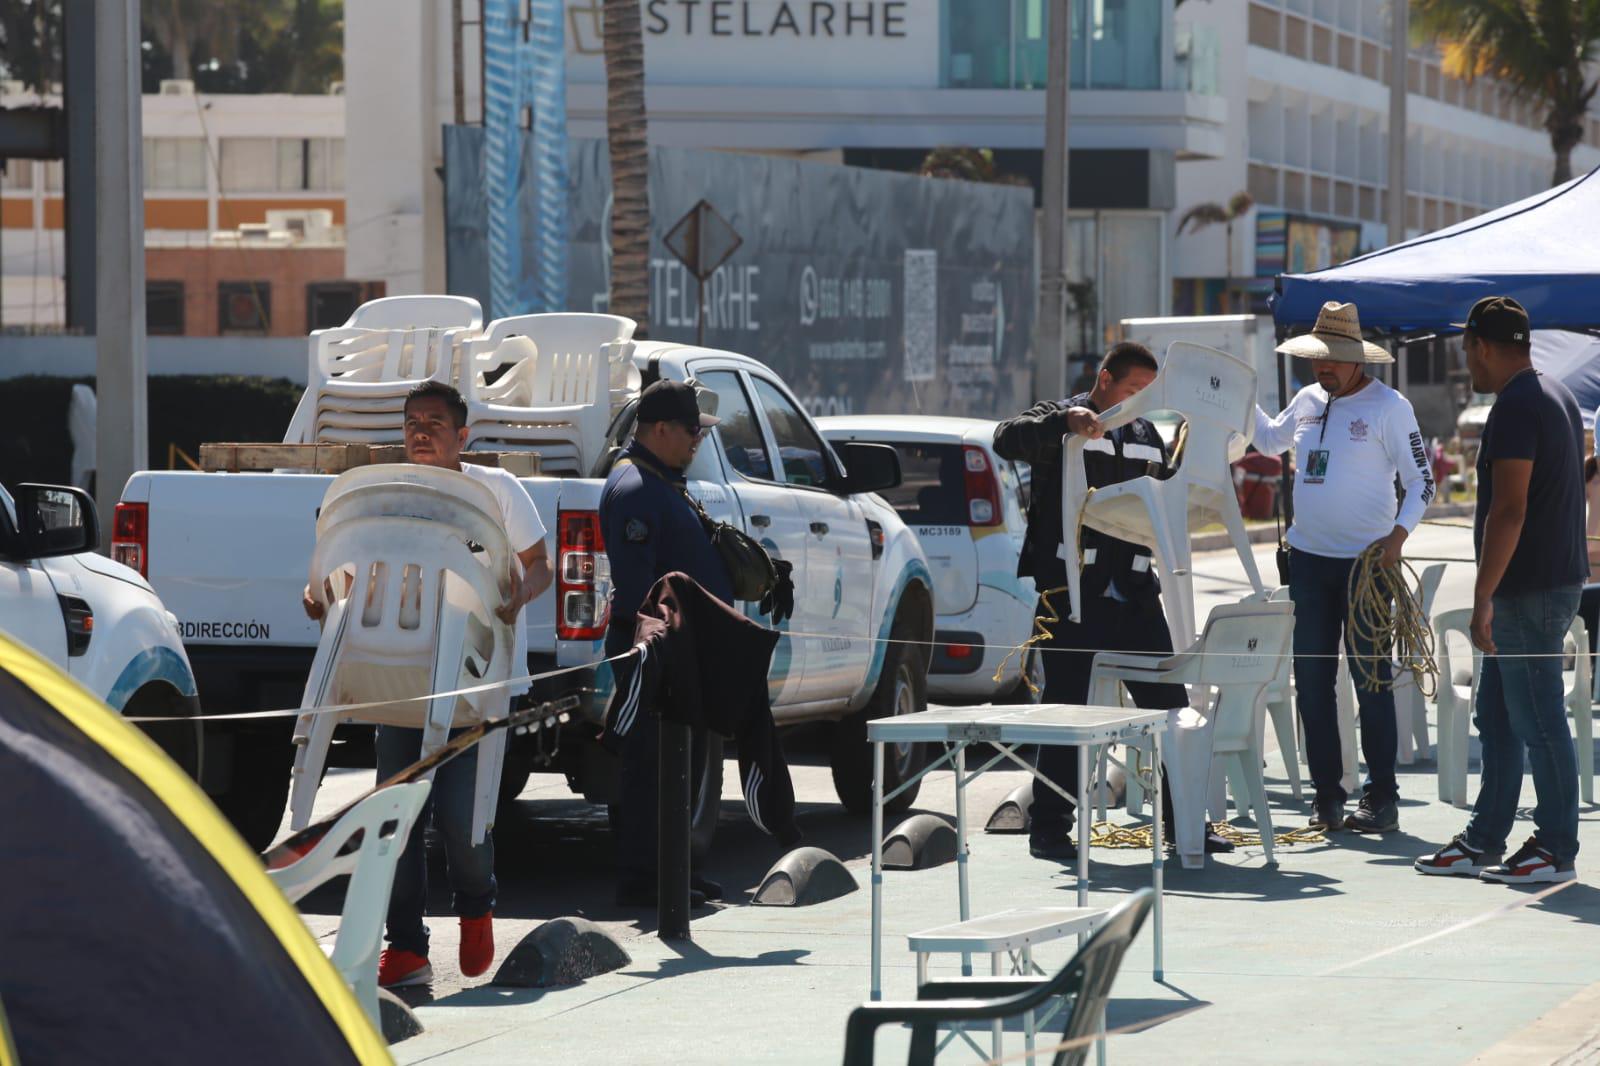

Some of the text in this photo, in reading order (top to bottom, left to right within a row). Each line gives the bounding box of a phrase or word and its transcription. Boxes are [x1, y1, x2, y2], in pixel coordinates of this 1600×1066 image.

[646, 0, 907, 38] STELARHE
[649, 259, 760, 330] TELARHE
[1409, 431, 1427, 468] MAYOR
